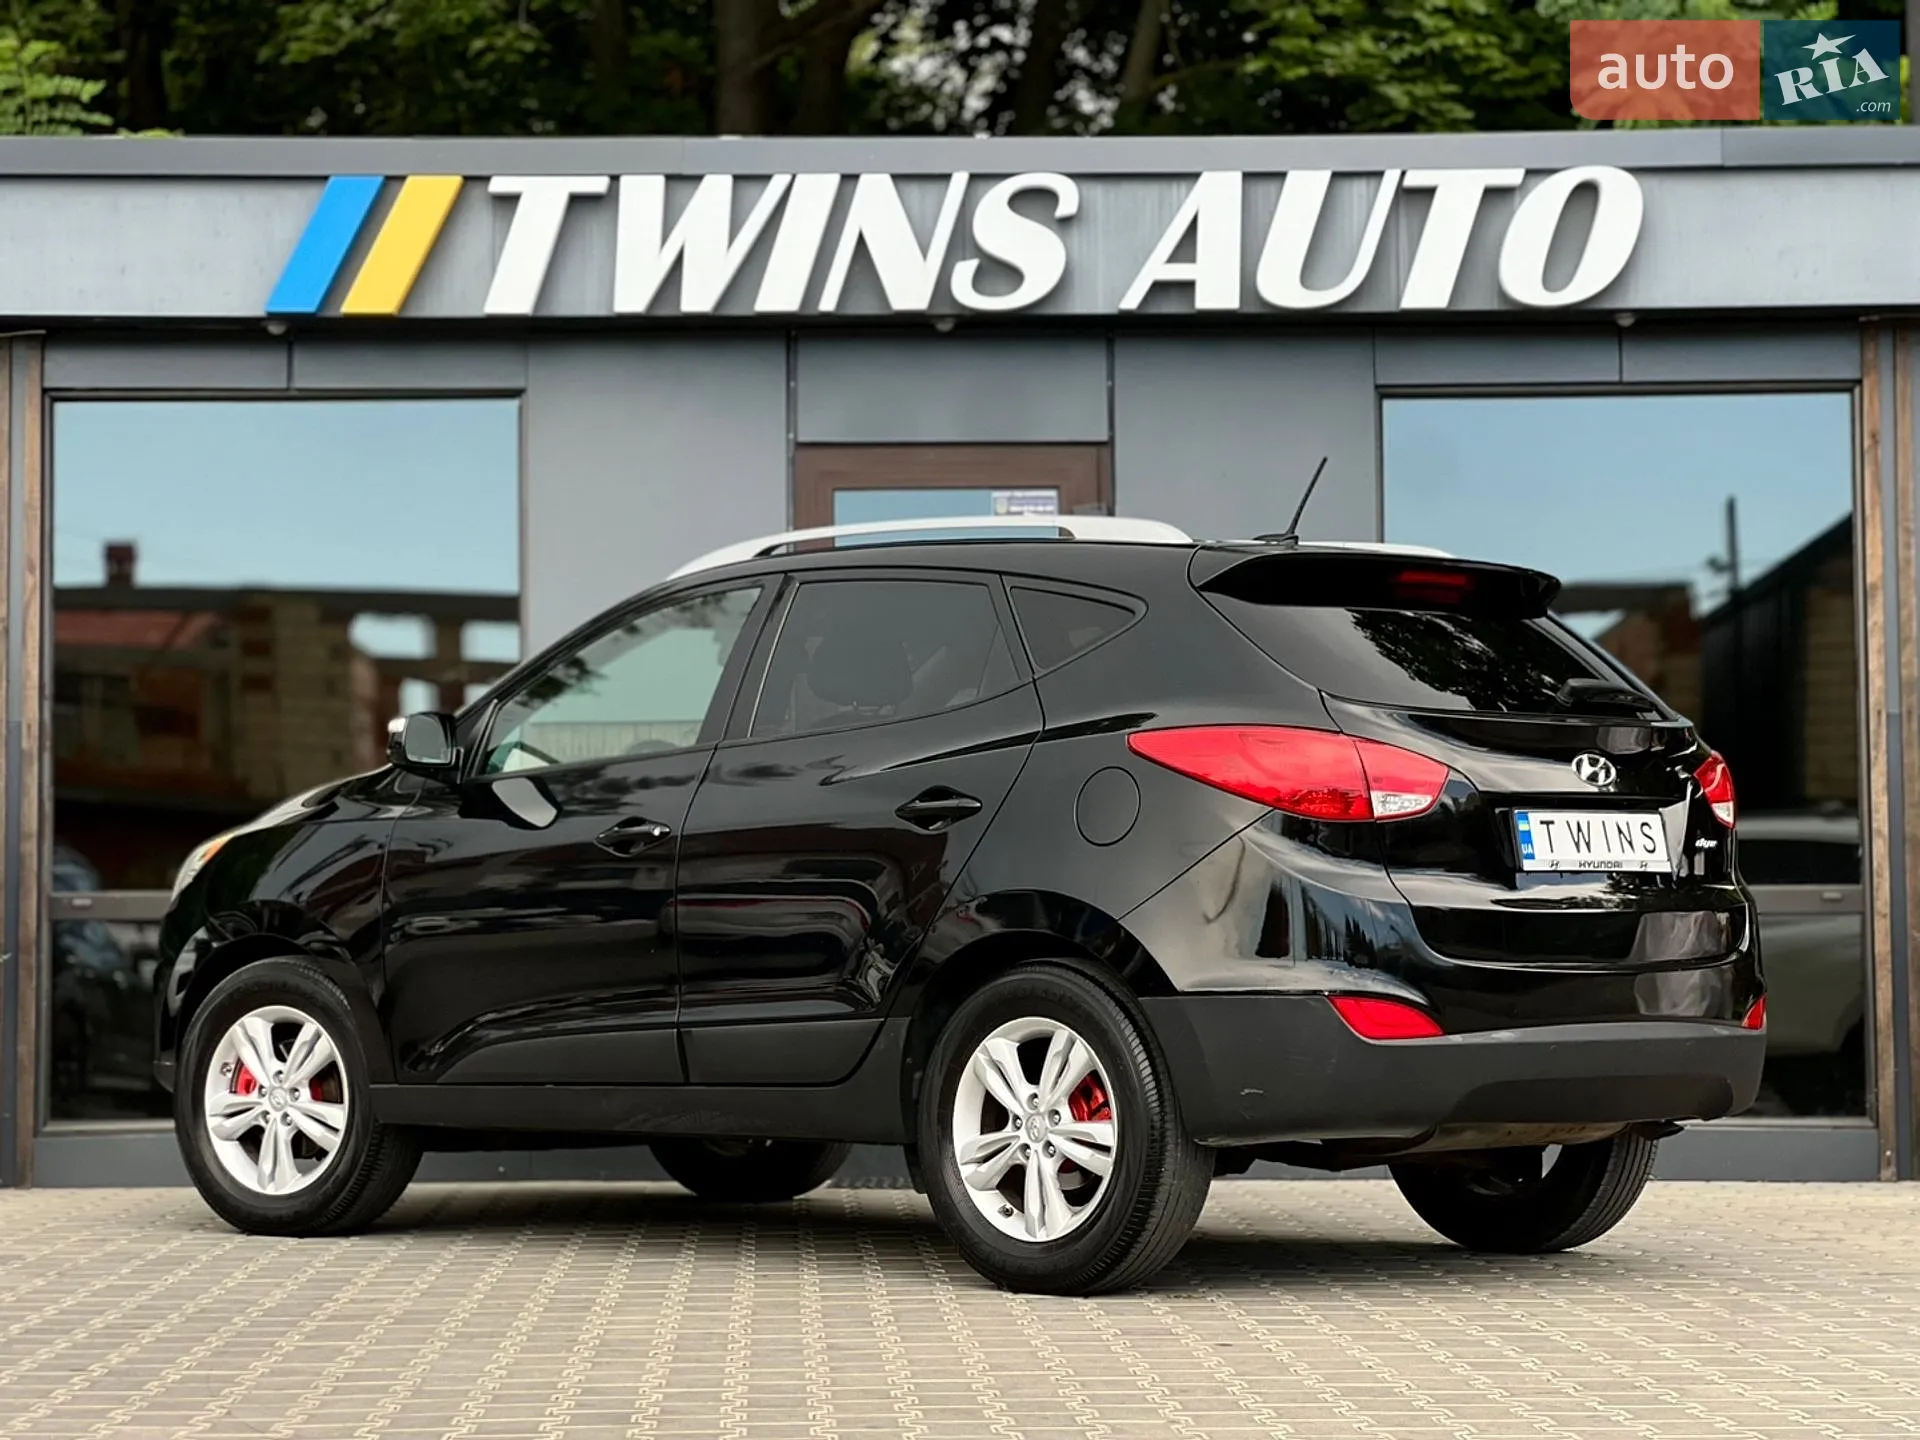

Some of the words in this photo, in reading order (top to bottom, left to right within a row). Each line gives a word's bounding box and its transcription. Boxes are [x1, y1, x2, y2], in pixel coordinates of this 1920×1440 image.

[483, 171, 1080, 315] TWINS
[1117, 165, 1645, 311] AUTO
[1522, 843, 1534, 854] UA
[1540, 820, 1657, 854] TWINS
